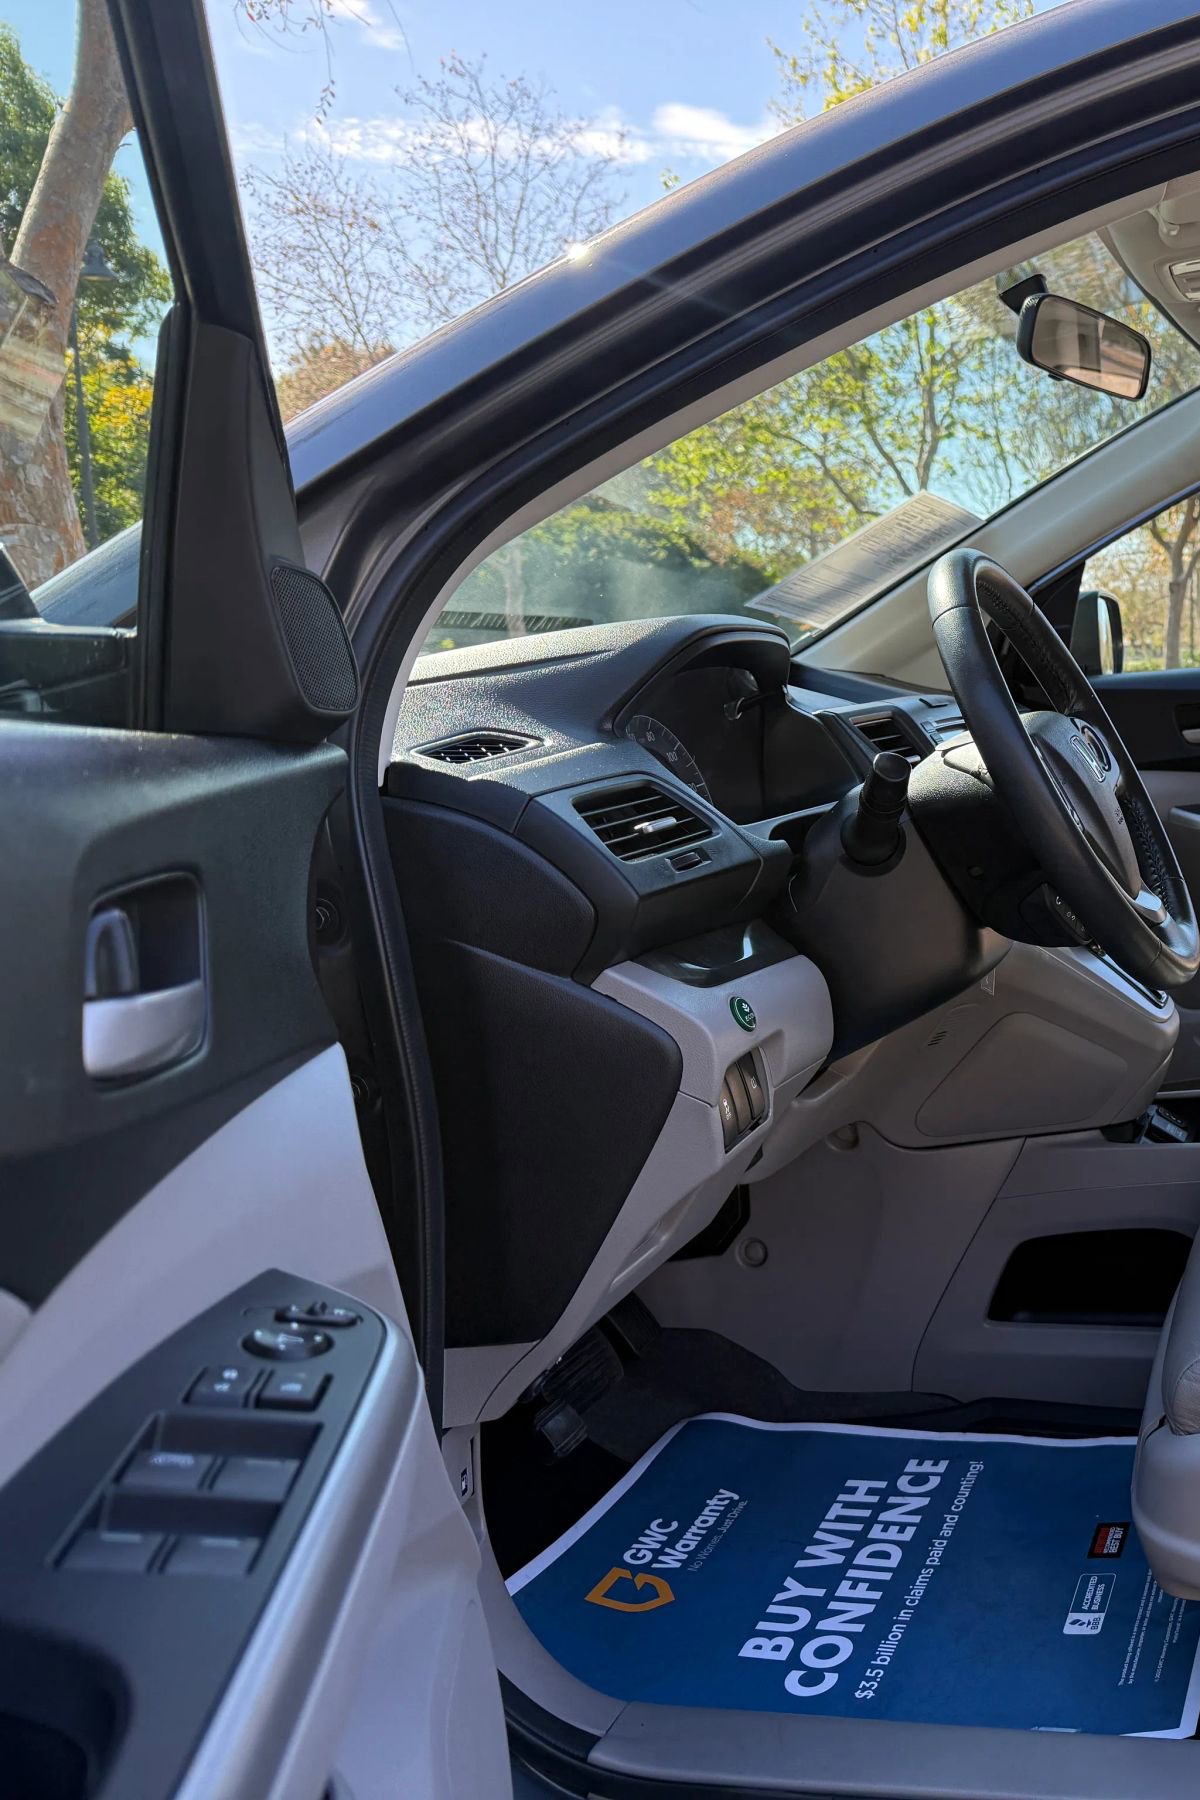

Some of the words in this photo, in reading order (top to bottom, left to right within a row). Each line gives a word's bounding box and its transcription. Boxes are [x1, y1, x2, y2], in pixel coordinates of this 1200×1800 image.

[666, 751, 678, 762] 100
[623, 1518, 679, 1565] GWC
[651, 1488, 740, 1568] Warranty
[688, 1560, 703, 1572] No
[717, 1516, 735, 1535] Just
[728, 1499, 748, 1519] Drive.
[1109, 1537, 1120, 1554] BEST
[1114, 1526, 1125, 1540] BUY
[738, 1576, 828, 1661] BUY
[793, 1479, 889, 1569] WITH
[784, 1458, 950, 1697] CONFIDENCE
[854, 1668, 884, 1700] $3.5
[870, 1623, 907, 1666] billion
[893, 1608, 915, 1621] in
[904, 1567, 934, 1607] claims
[925, 1538, 948, 1566] paid
[939, 1514, 959, 1538] and
[950, 1460, 984, 1512] counting!
[1081, 1575, 1098, 1611] ACCREDITED
[1090, 1583, 1106, 1611] BUSINESS
[1090, 1617, 1101, 1631] BBB
